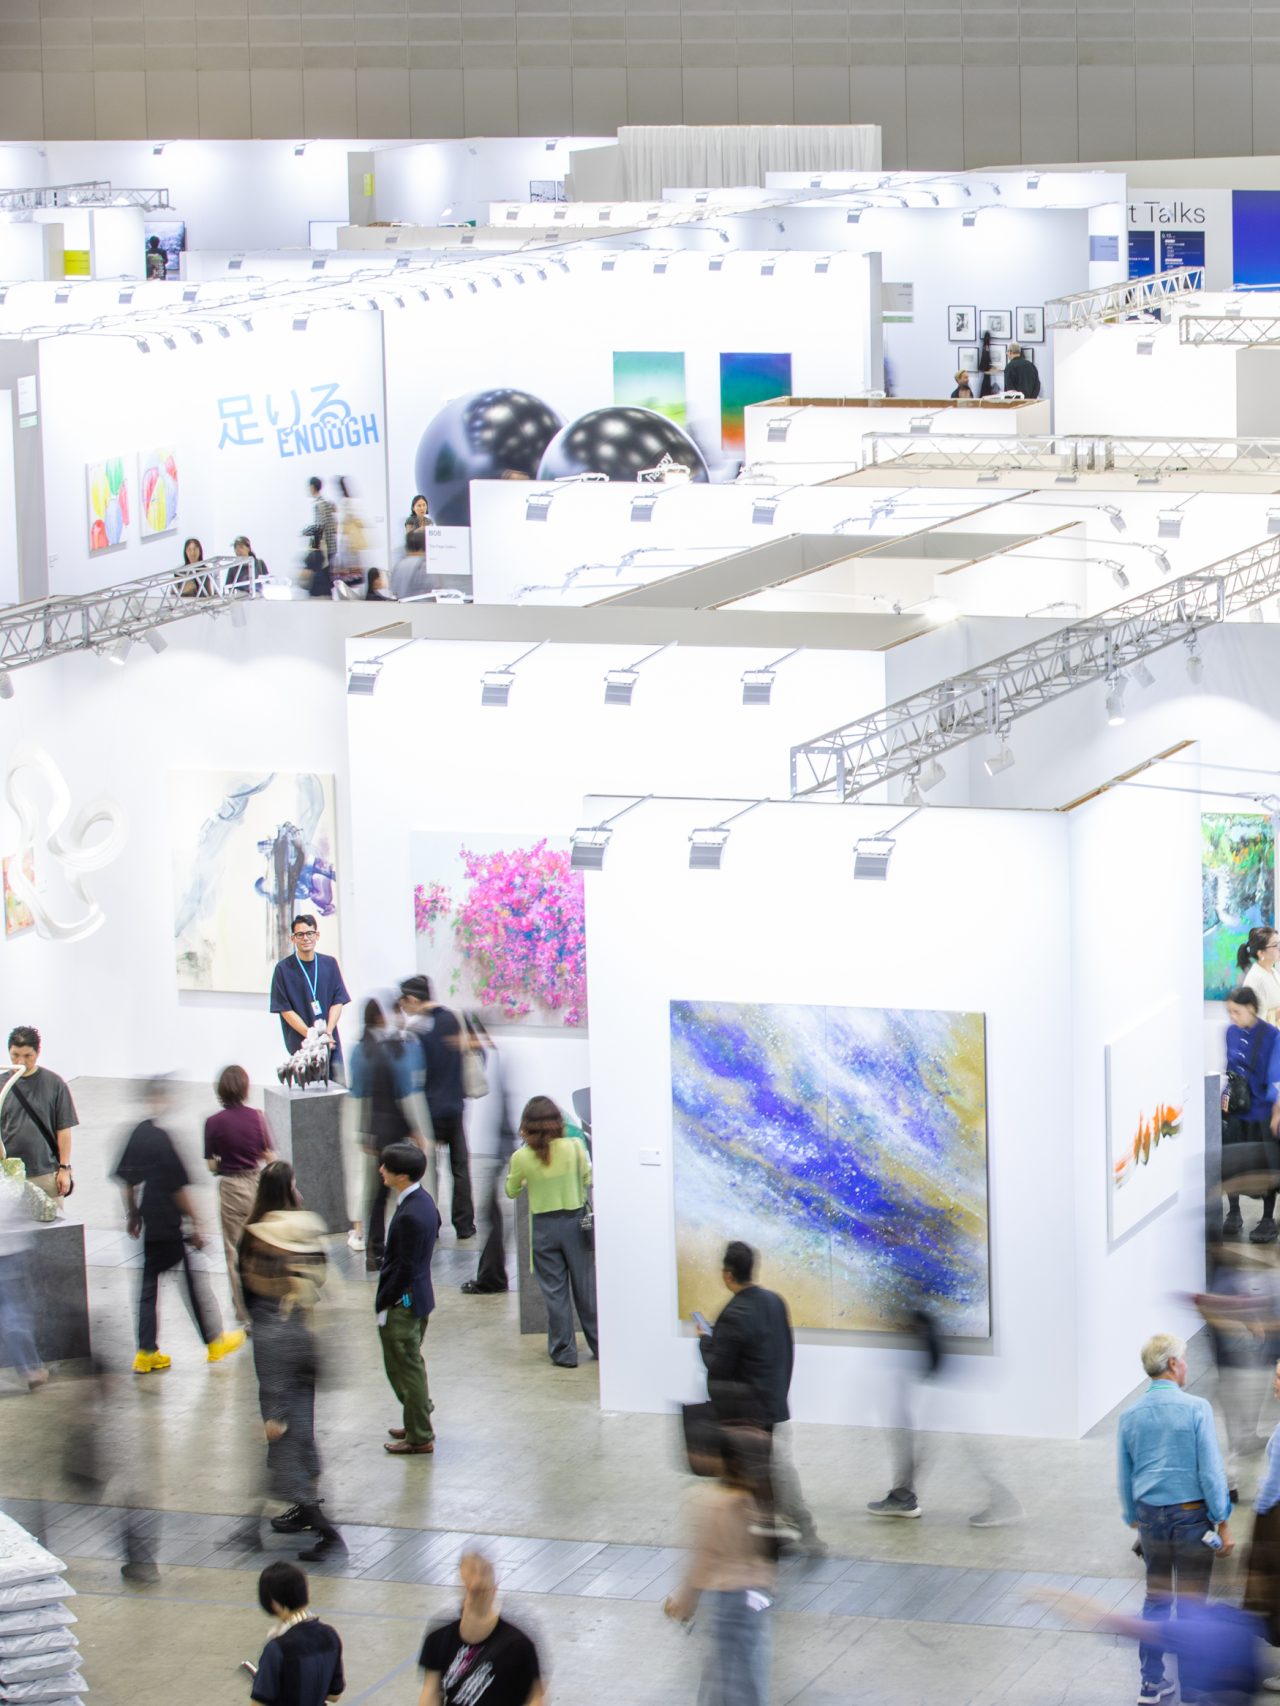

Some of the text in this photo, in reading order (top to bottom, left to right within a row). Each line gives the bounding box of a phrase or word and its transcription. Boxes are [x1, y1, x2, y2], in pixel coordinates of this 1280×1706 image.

[1144, 201, 1206, 223] Talks
[217, 382, 351, 450] 足りる
[276, 413, 380, 458] ENOUGH
